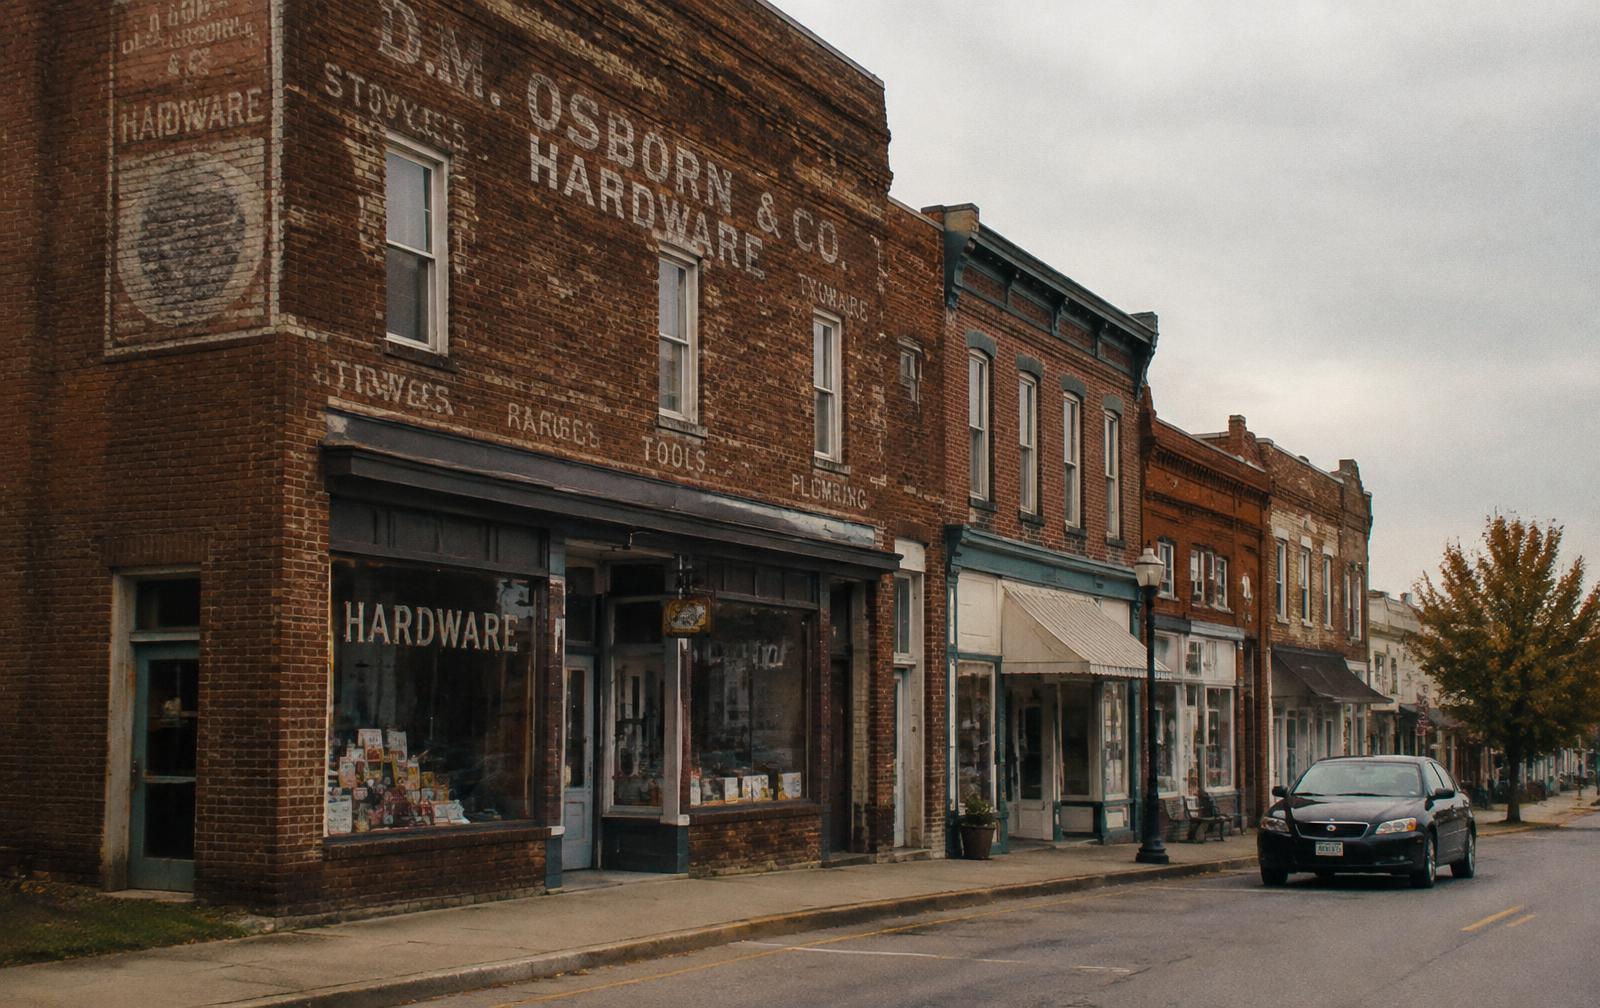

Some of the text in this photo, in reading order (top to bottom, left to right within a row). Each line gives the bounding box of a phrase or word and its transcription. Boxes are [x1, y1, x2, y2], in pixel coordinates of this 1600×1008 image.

[527, 72, 733, 216] OSBORN
[757, 192, 782, 239] &
[529, 133, 766, 281] HARDWARE
[642, 436, 705, 473] TOOLS
[343, 600, 518, 652] HARDWARE
